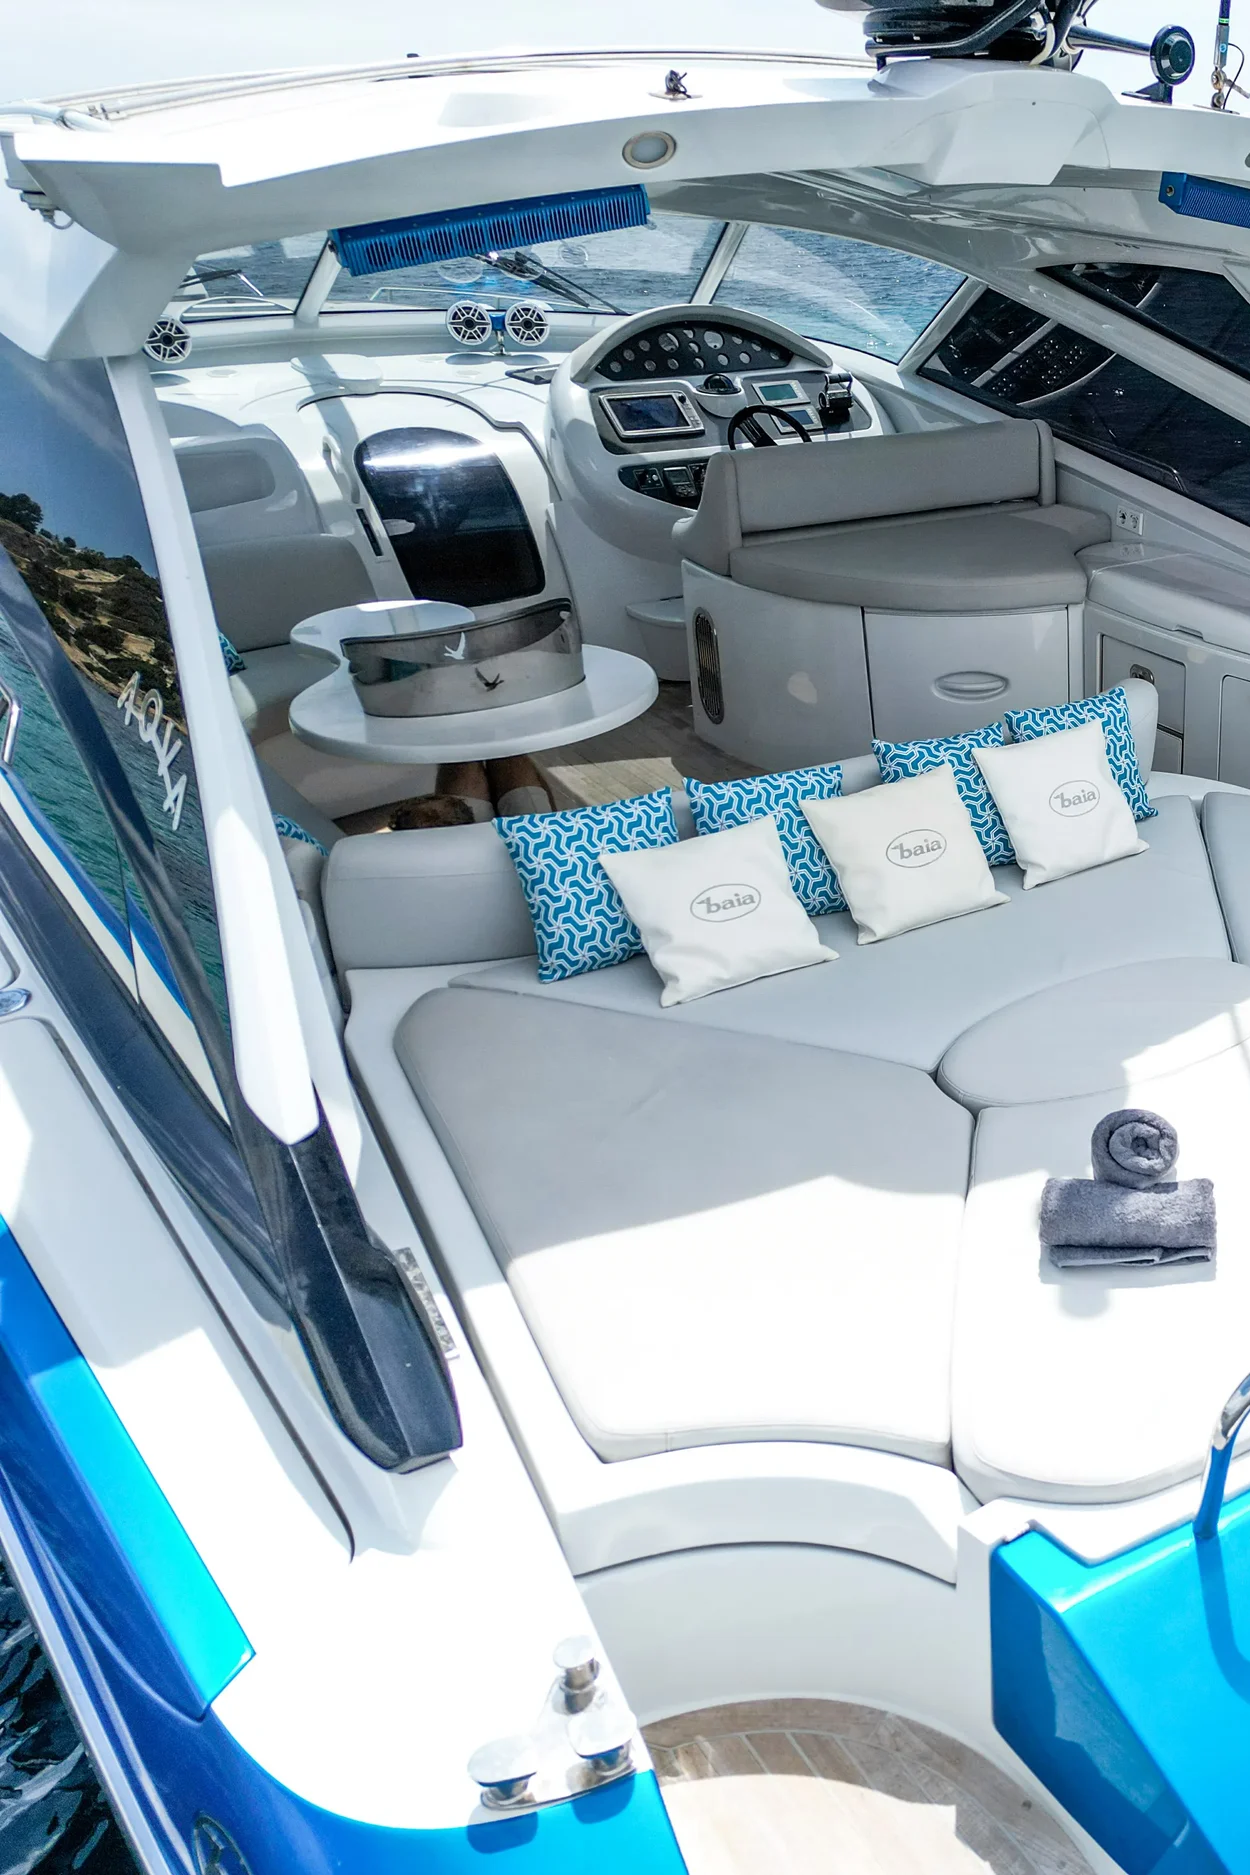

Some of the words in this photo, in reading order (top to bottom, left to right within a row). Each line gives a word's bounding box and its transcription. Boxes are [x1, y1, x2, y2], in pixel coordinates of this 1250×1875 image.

[1053, 789, 1097, 808] baia
[891, 838, 942, 860] baia
[696, 893, 756, 914] baia
